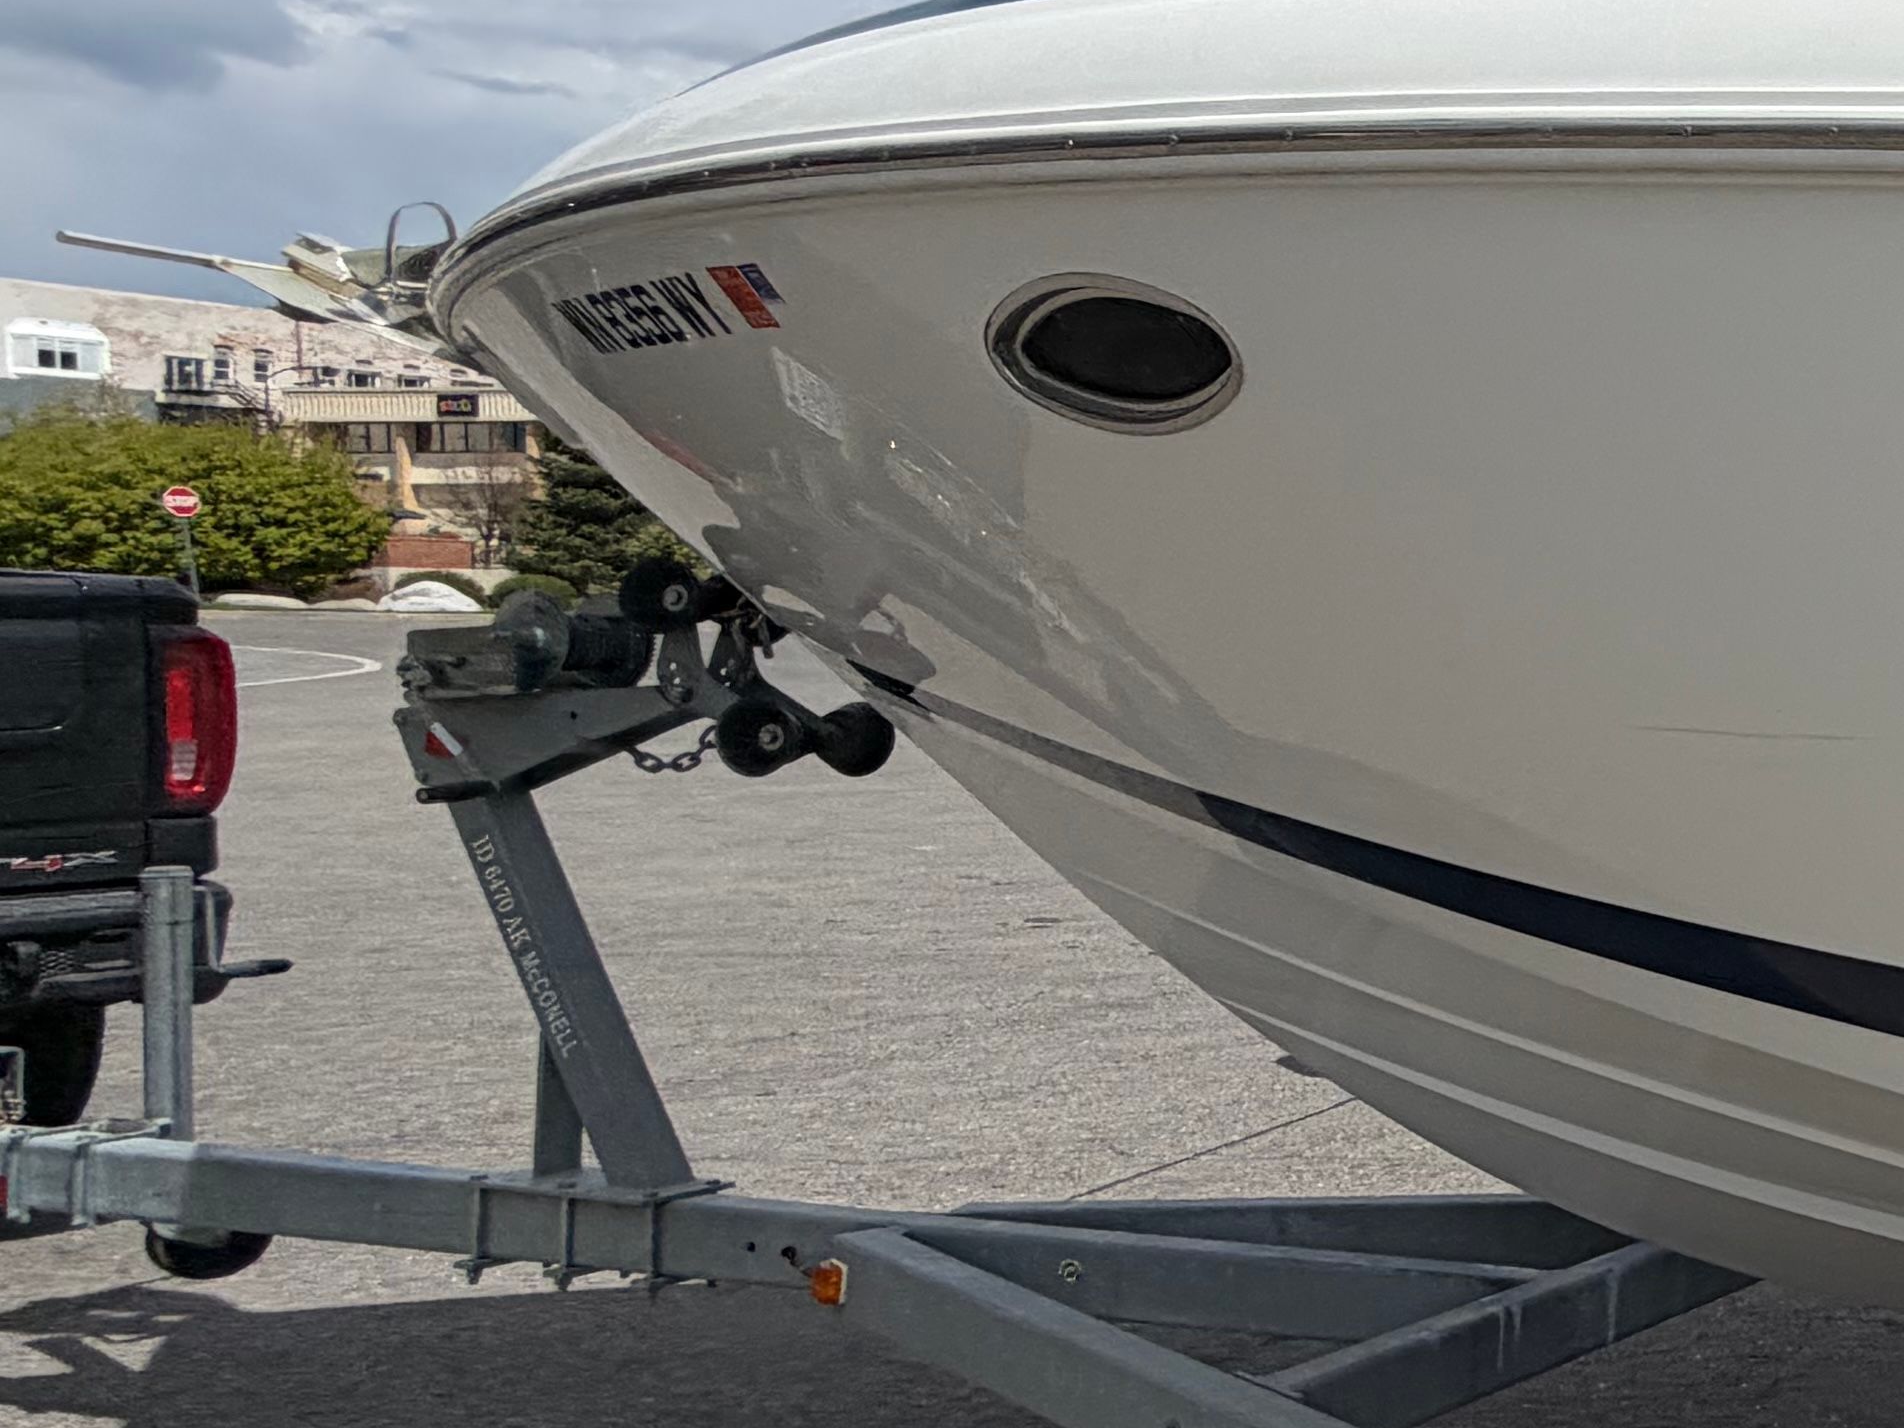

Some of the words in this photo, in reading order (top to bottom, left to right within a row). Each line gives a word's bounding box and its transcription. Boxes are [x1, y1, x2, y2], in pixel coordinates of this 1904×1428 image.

[584, 284, 690, 349] 8356
[471, 834, 496, 864] ID
[502, 915, 532, 949] AK
